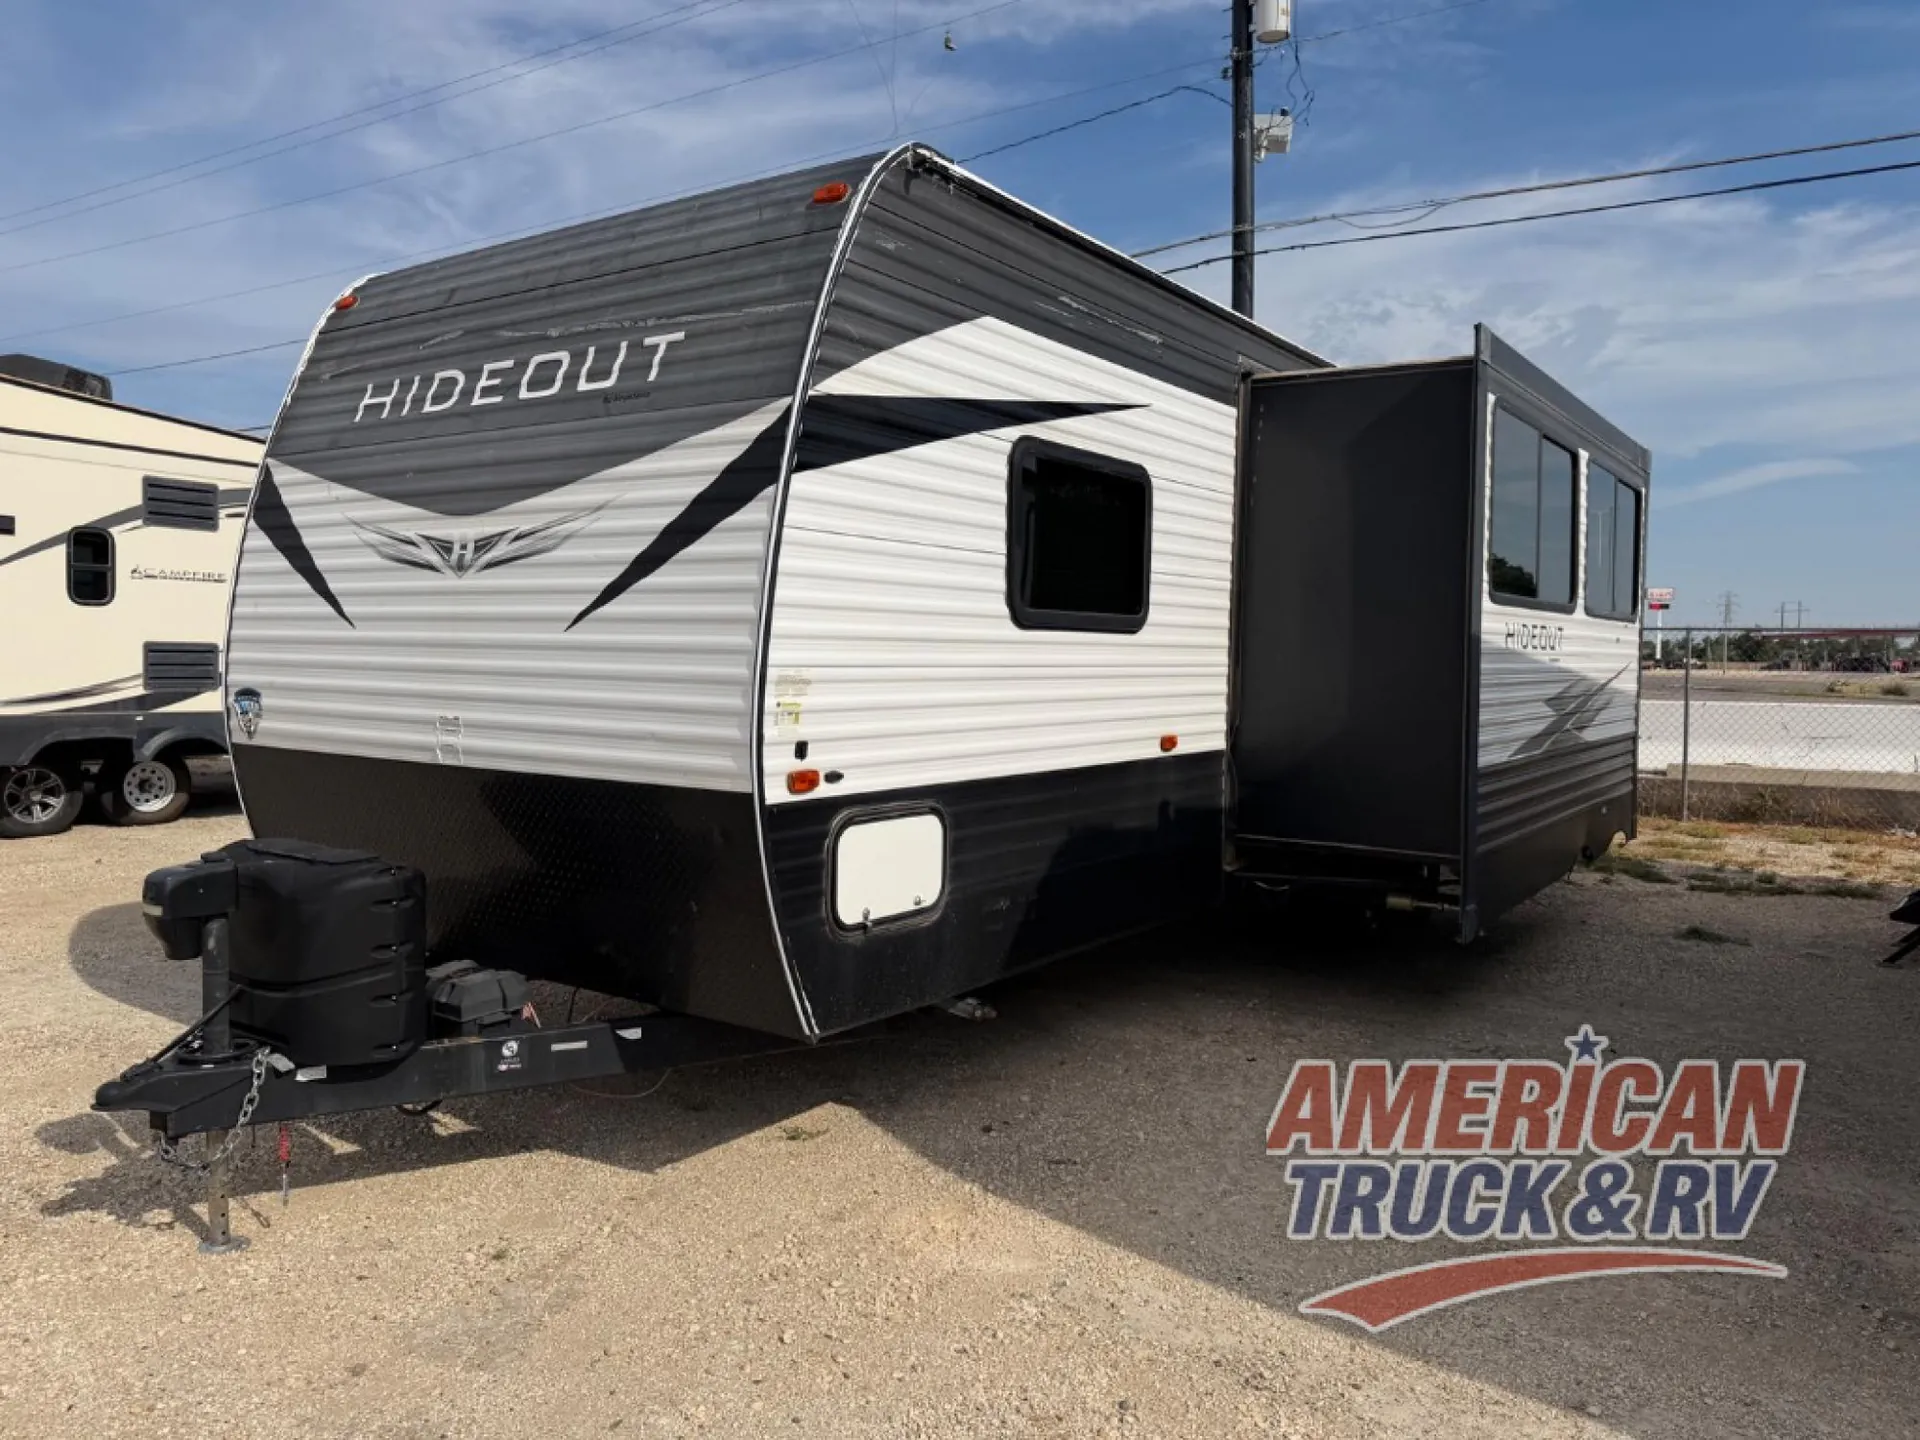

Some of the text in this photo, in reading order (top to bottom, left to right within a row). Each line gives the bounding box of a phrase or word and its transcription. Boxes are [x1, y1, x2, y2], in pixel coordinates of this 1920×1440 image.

[353, 331, 686, 423] HIDEOUT
[143, 567, 228, 583] CAMPFIRE
[1505, 622, 1564, 651] HIDEOUT
